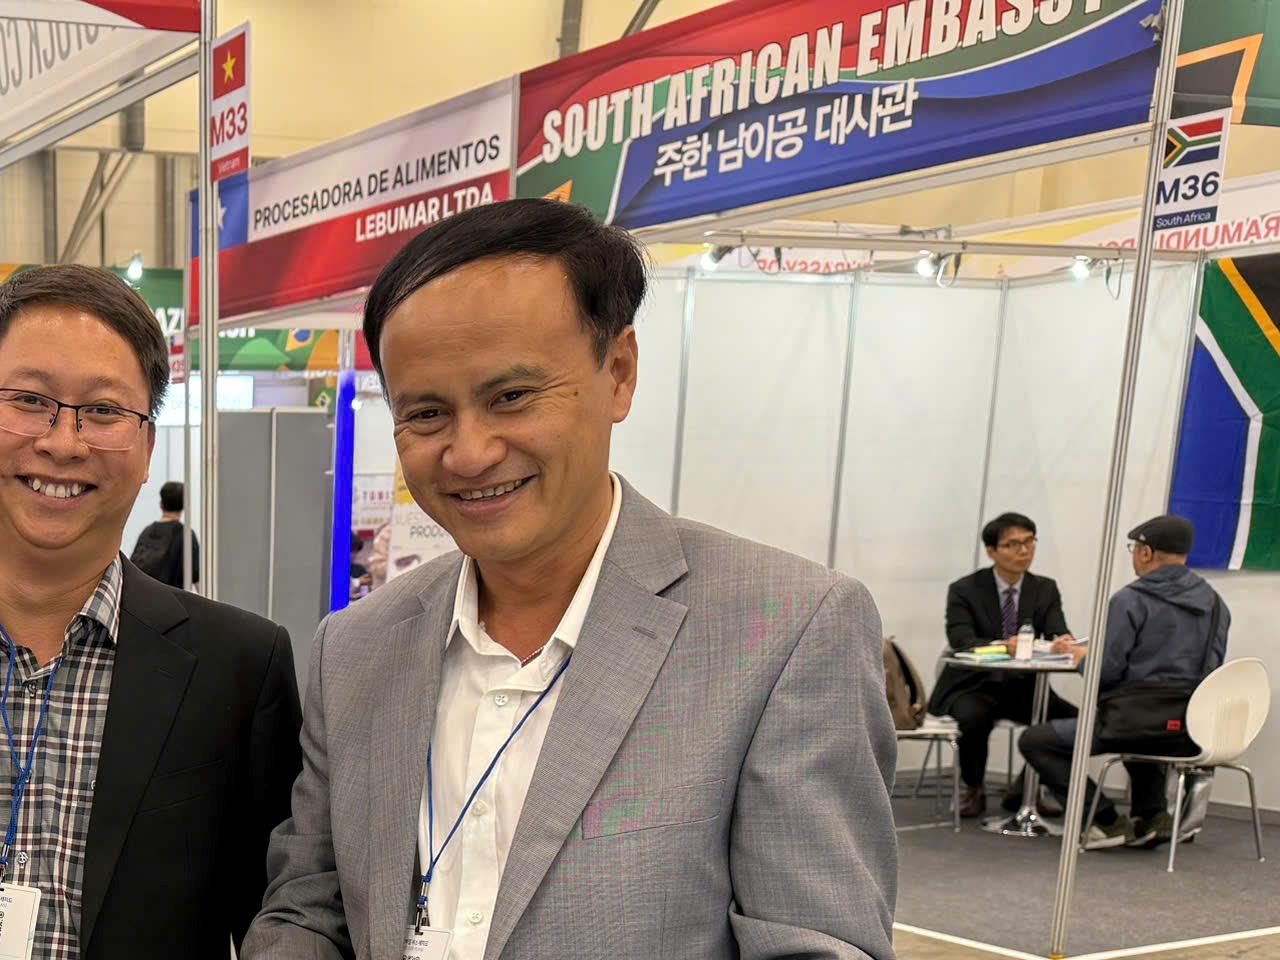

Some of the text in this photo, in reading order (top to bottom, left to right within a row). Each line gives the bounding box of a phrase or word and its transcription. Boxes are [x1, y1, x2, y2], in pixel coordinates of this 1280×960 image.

[542, 80, 656, 163] SOUTH
[663, 22, 843, 131] AFRICAN
[210, 102, 248, 148] M33
[653, 78, 919, 187] 주한 남아공 대사관
[254, 134, 501, 230] PROCESADORA DE ALIMENTOS
[355, 182, 494, 242] LEBUMAR LTDA
[1155, 171, 1220, 205] M36
[1156, 211, 1211, 228] South Africa
